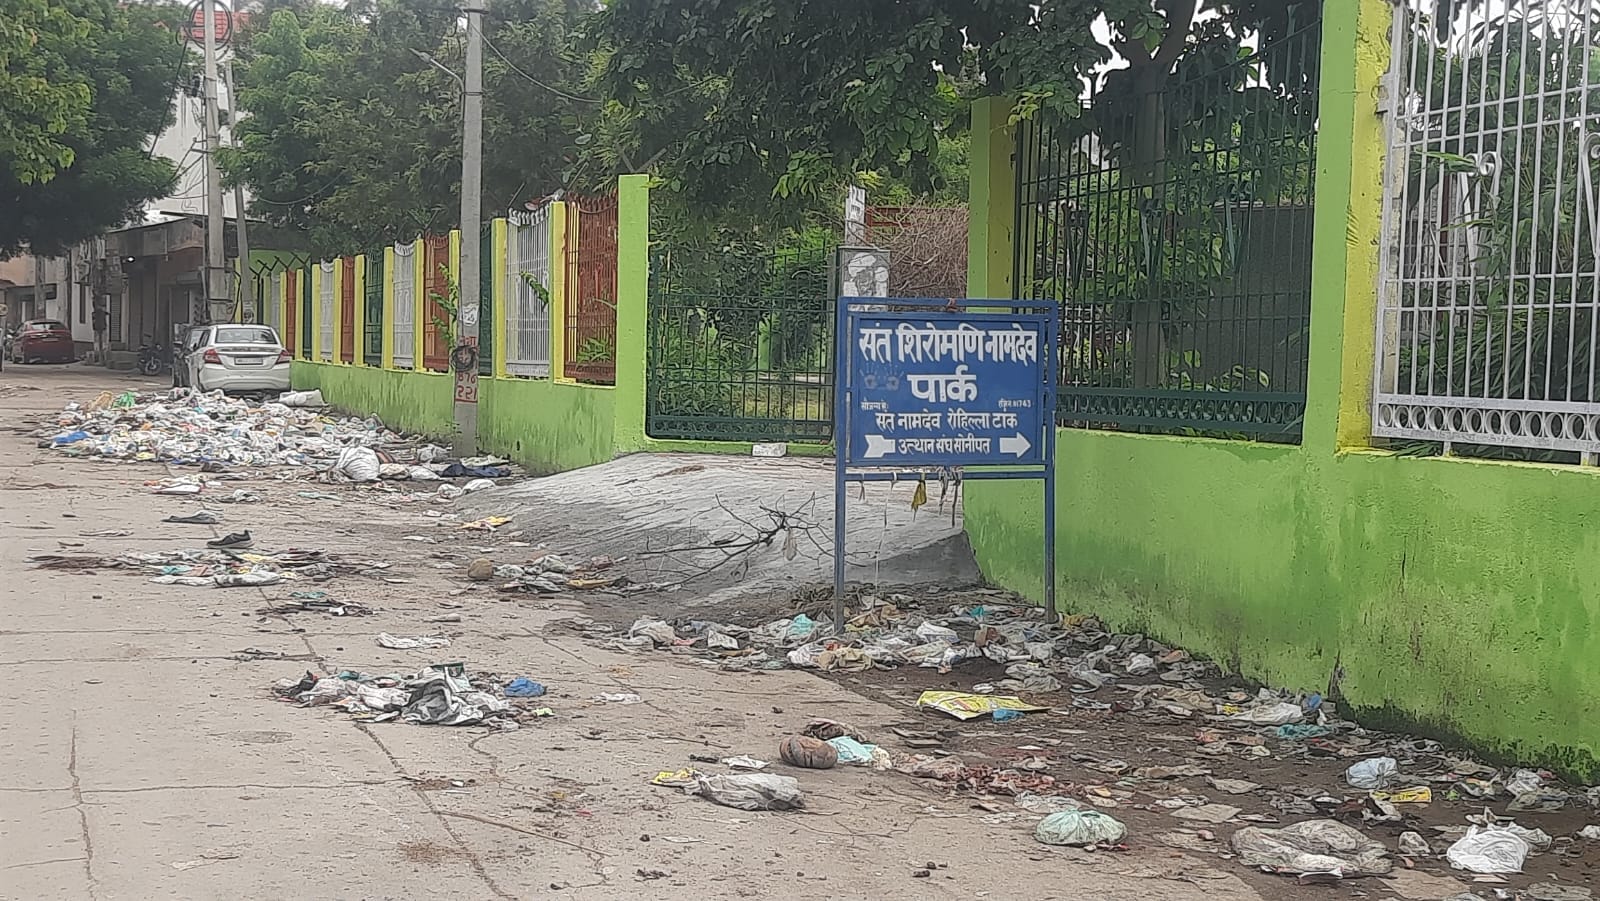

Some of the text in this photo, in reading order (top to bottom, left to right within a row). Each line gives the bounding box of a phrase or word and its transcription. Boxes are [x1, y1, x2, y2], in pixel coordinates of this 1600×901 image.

[859, 322, 1038, 366] संत शिरोमणि नामदेव
[907, 365, 978, 403] पार्क
[875, 409, 895, 432] संत
[898, 408, 942, 431] नामदेव
[947, 407, 990, 430] रोहिल्ला
[898, 433, 991, 455] उत्थान संघ सोनीपत
